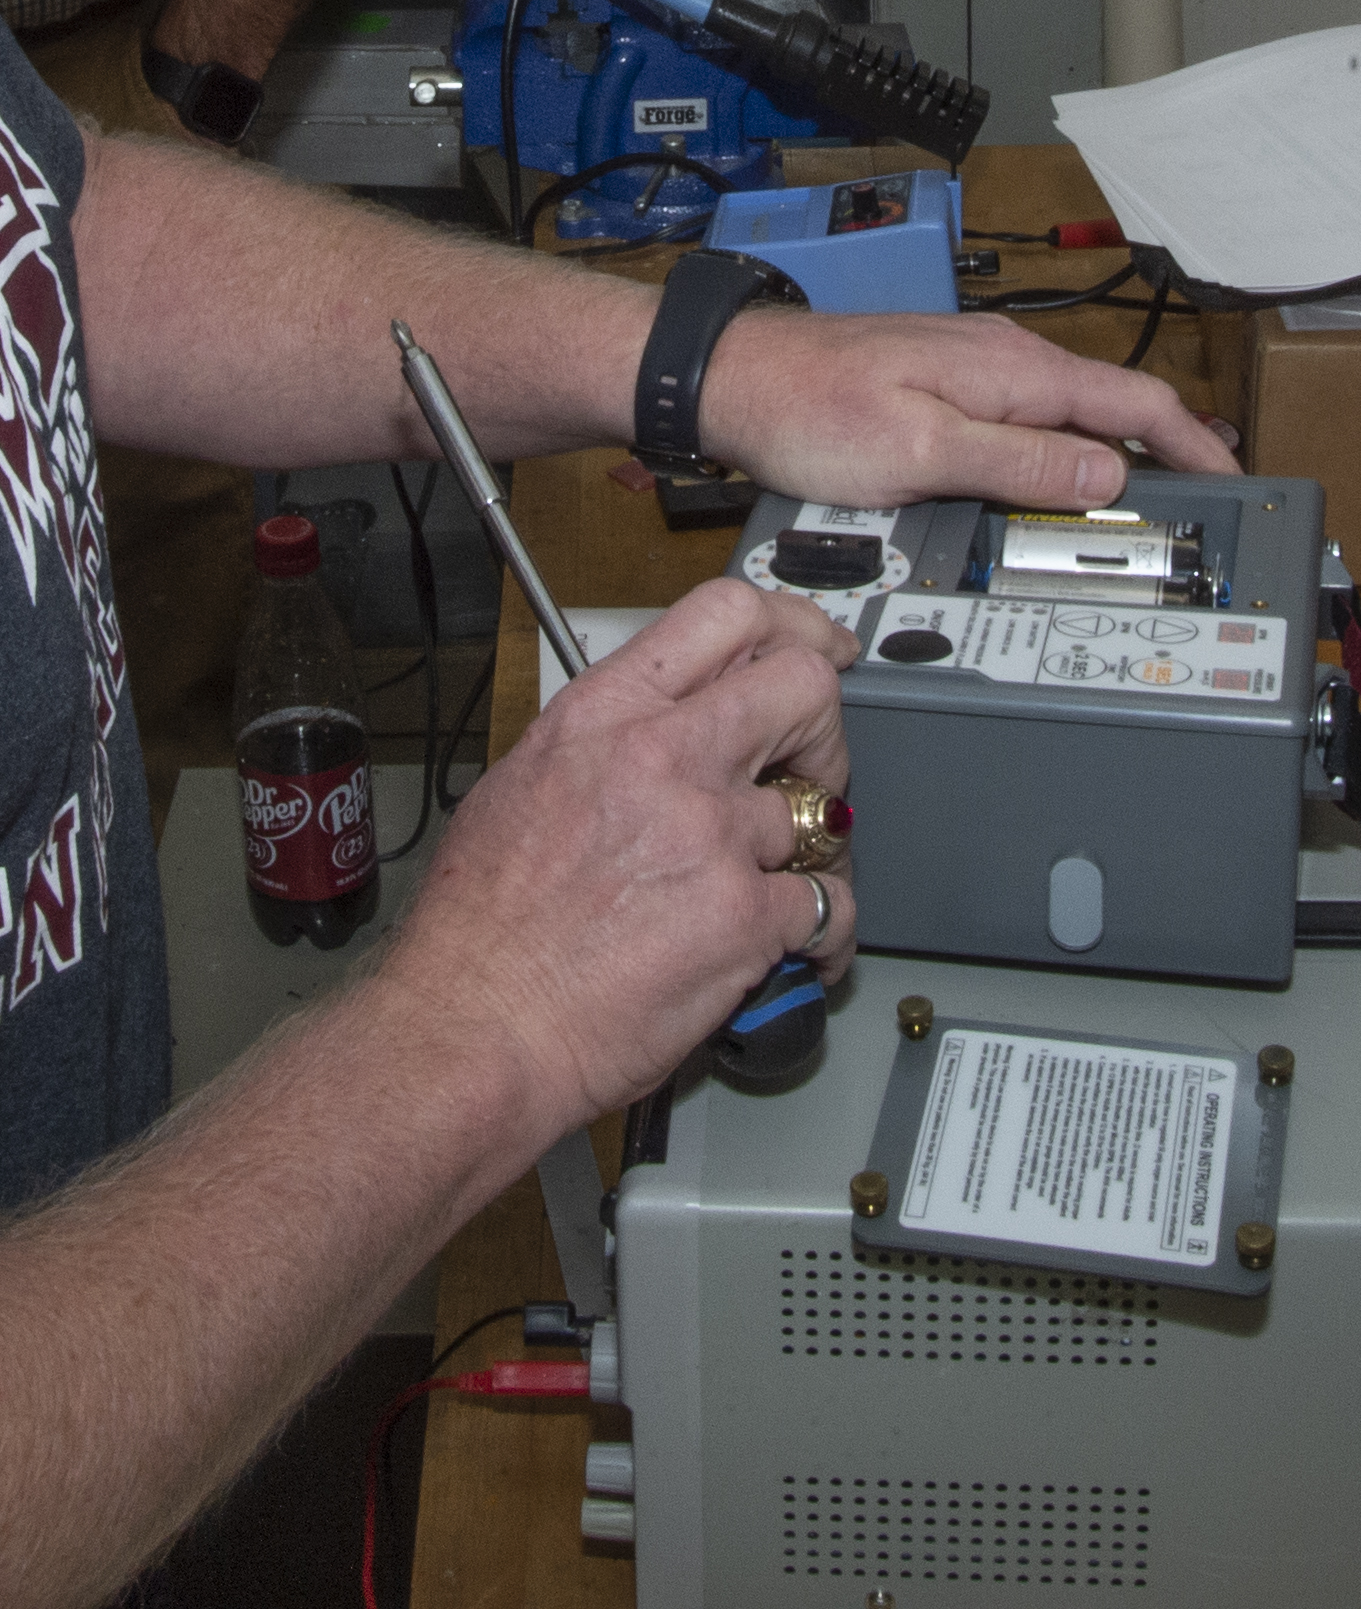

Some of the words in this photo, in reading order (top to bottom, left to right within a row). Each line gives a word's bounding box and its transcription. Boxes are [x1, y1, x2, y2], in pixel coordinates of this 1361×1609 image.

[644, 106, 696, 125] Forge
[1071, 661, 1087, 679] SEC
[247, 779, 278, 805] Dr
[347, 836, 364, 858] 23
[1199, 1092, 1220, 1148] OPERATING
[1189, 1150, 1213, 1227] INSTRUCTIONS
